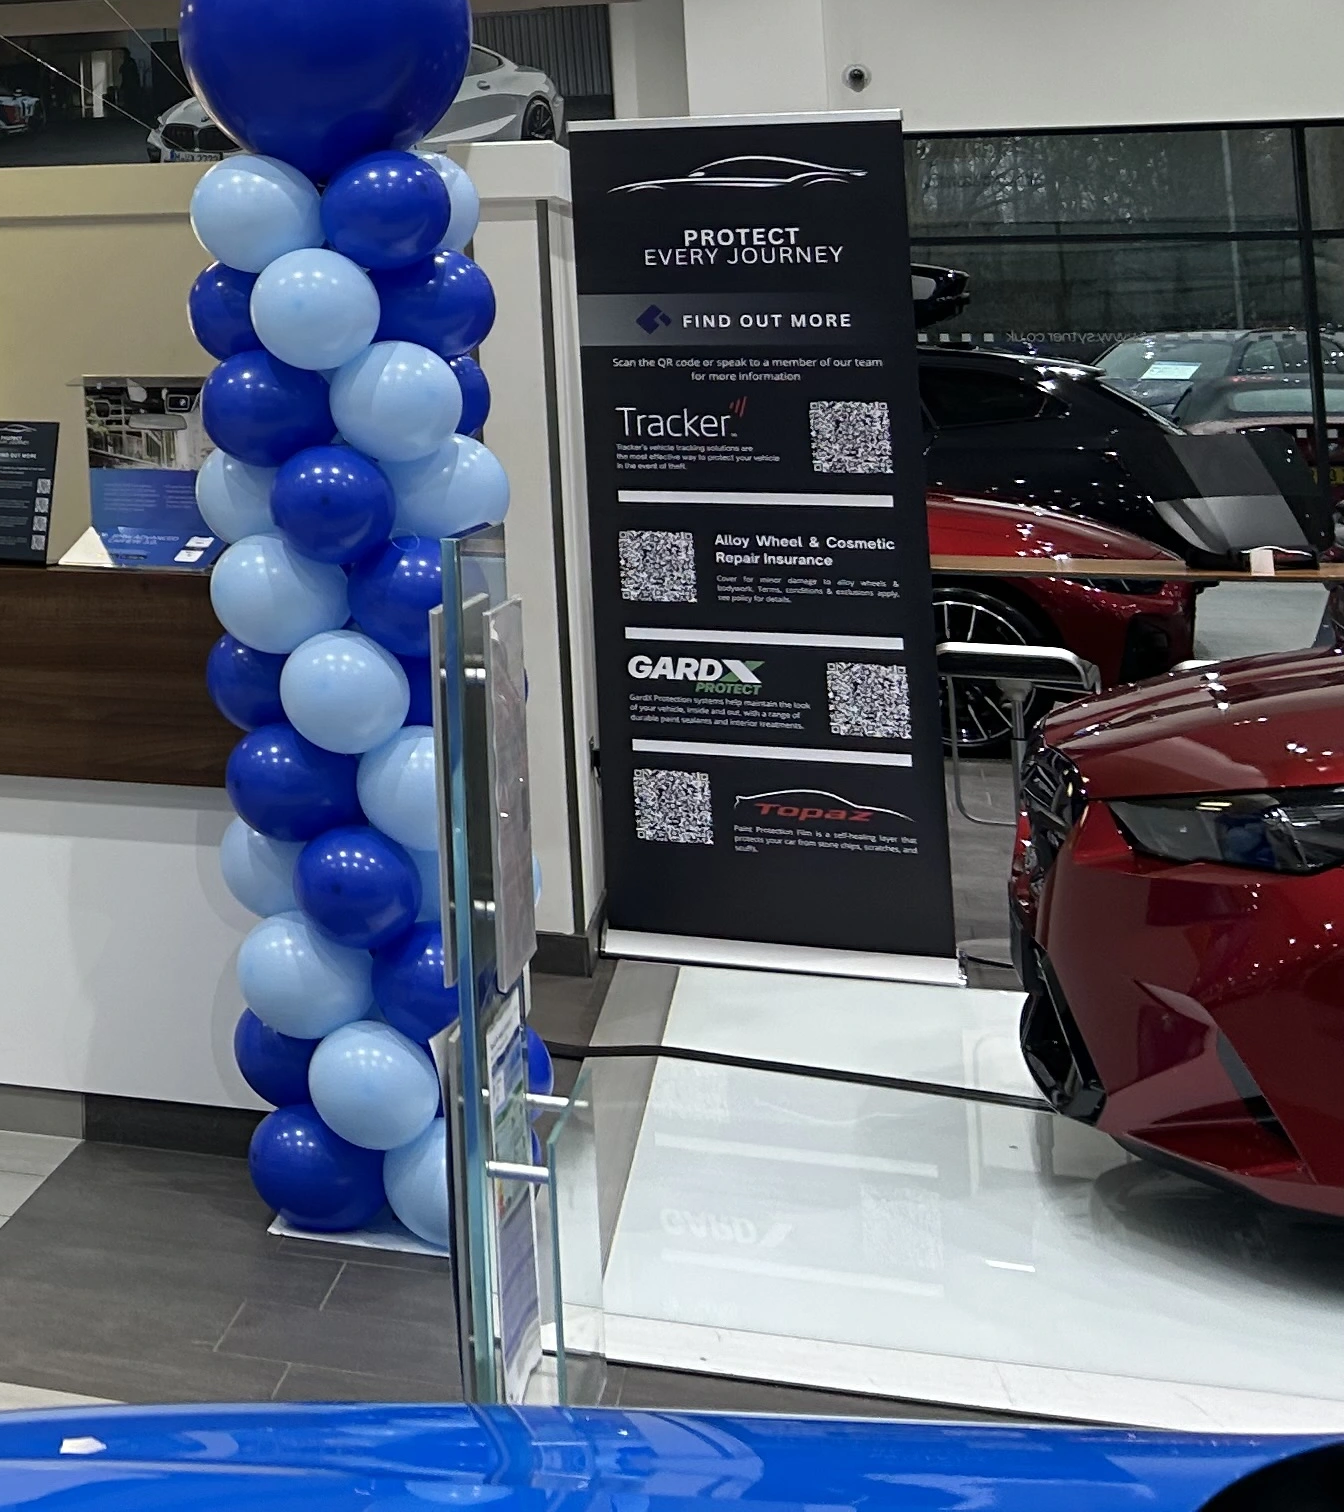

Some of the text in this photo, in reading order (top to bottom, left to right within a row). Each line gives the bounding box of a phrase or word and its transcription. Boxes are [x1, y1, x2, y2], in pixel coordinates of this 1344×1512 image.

[684, 227, 800, 247] PROTECT
[644, 246, 844, 266] EVERY JOURNEY
[682, 313, 851, 328] FIND OUT MORE
[613, 358, 636, 367] Scan
[638, 358, 655, 367] the
[657, 358, 673, 368] QR
[675, 358, 700, 367] code
[716, 358, 747, 368] speak
[749, 358, 760, 367] to
[772, 357, 818, 367] member
[820, 357, 832, 367] of
[833, 359, 852, 367] our
[855, 358, 883, 367] team
[692, 371, 801, 381] for more information
[615, 406, 732, 438] Tracker
[715, 535, 896, 550] Alloy Wheel & Cosmetic
[715, 552, 834, 566] Repair Insurance
[628, 655, 765, 684] GARDX
[696, 682, 762, 696] PROTECT
[754, 802, 874, 822] Topaz
